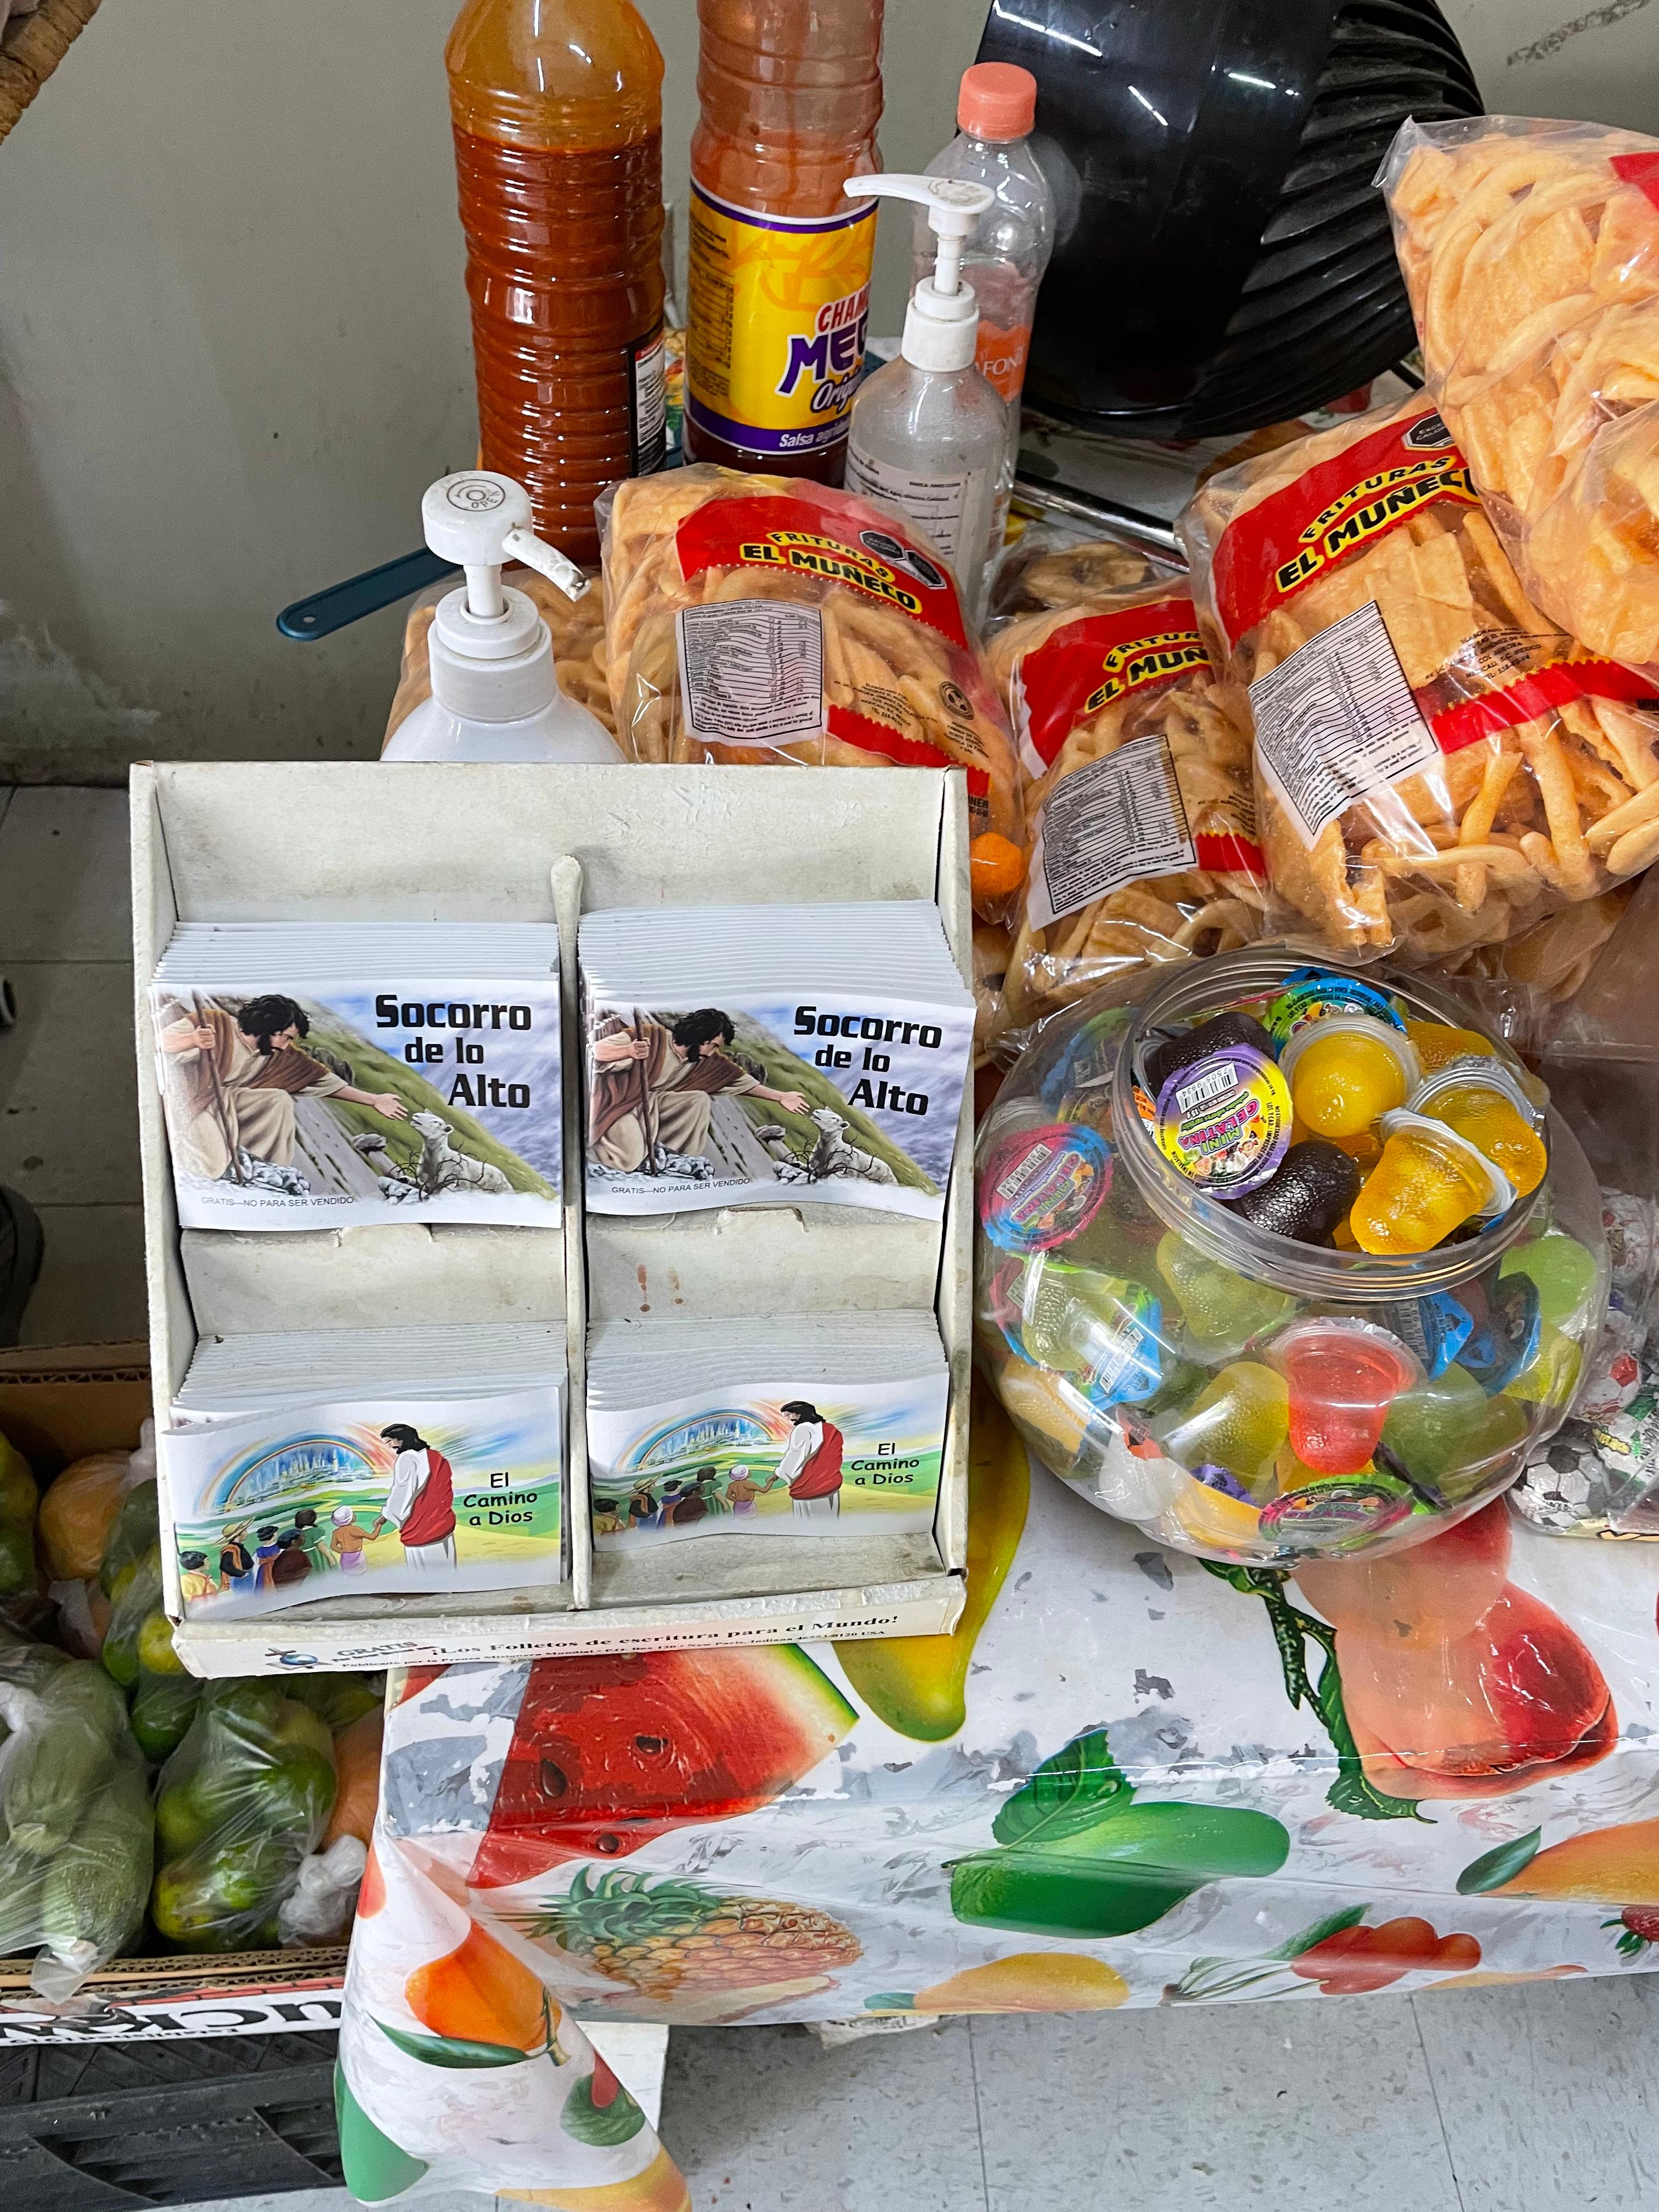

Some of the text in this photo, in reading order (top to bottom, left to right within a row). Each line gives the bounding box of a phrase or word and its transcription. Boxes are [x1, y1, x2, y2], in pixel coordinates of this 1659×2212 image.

[779, 432, 814, 448] Salsa
[471, 488, 501, 509] OPEN
[1301, 456, 1451, 539] FRITURAS
[771, 532, 890, 578] FRITURAS
[743, 545, 779, 561] EL
[791, 550, 916, 610] MUÑECO
[1278, 551, 1317, 589] EL
[1105, 632, 1200, 668] FRITUR
[1088, 647, 1209, 710] EL MUÑ
[375, 994, 532, 1031] Socorro
[793, 1005, 943, 1049] Socorro
[405, 1036, 484, 1065] de lo
[815, 1045, 891, 1074] de lo
[447, 1073, 531, 1109] Alto
[848, 1079, 929, 1116] Alto
[1179, 1099, 1260, 1149] GELATINA
[1201, 1127, 1242, 1154] MINI
[668, 1184, 692, 1193] PARA
[693, 1182, 711, 1190] SER
[713, 1177, 751, 1189] VENDIDO
[288, 1198, 308, 1207] SER
[310, 1196, 354, 1206] VENDIDO
[878, 1442, 896, 1456] El
[490, 1471, 509, 1488] El
[850, 1457, 920, 1473] Camino
[855, 1471, 914, 1486] a Dios
[463, 1490, 538, 1509] Camino
[469, 1509, 533, 1526] a Dios
[490, 1641, 578, 1651] Folletos
[619, 1633, 719, 1644] escritura
[727, 1628, 778, 1638] para
[811, 1616, 899, 1630] Mundo!
[337, 1641, 419, 1657] GRATIS
